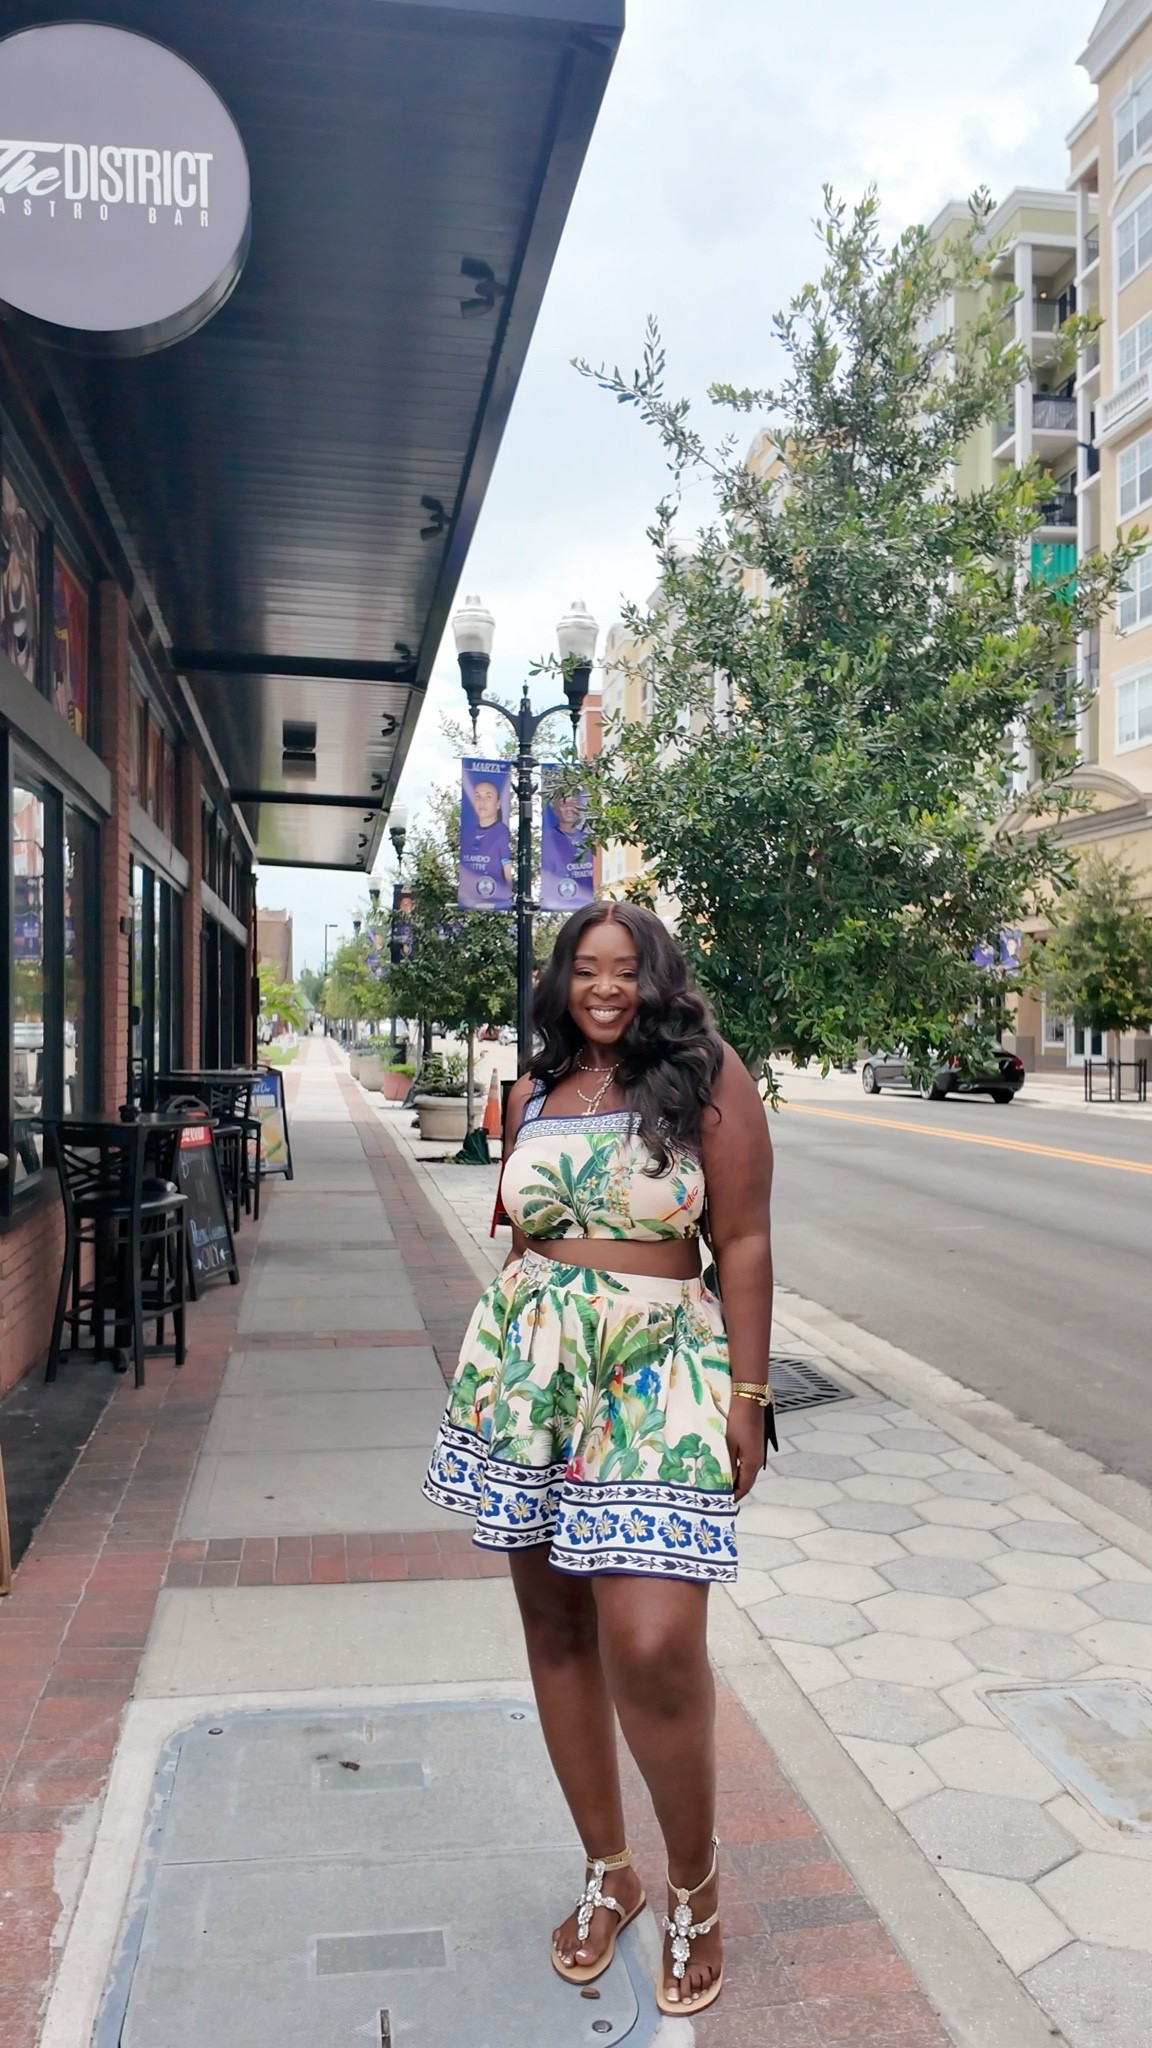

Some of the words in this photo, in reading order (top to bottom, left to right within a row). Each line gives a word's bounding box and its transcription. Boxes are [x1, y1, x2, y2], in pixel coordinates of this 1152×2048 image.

[0, 140, 64, 196] The
[64, 143, 213, 208] DISTRICT
[149, 207, 209, 227] BAR
[472, 762, 500, 773] MARTA
